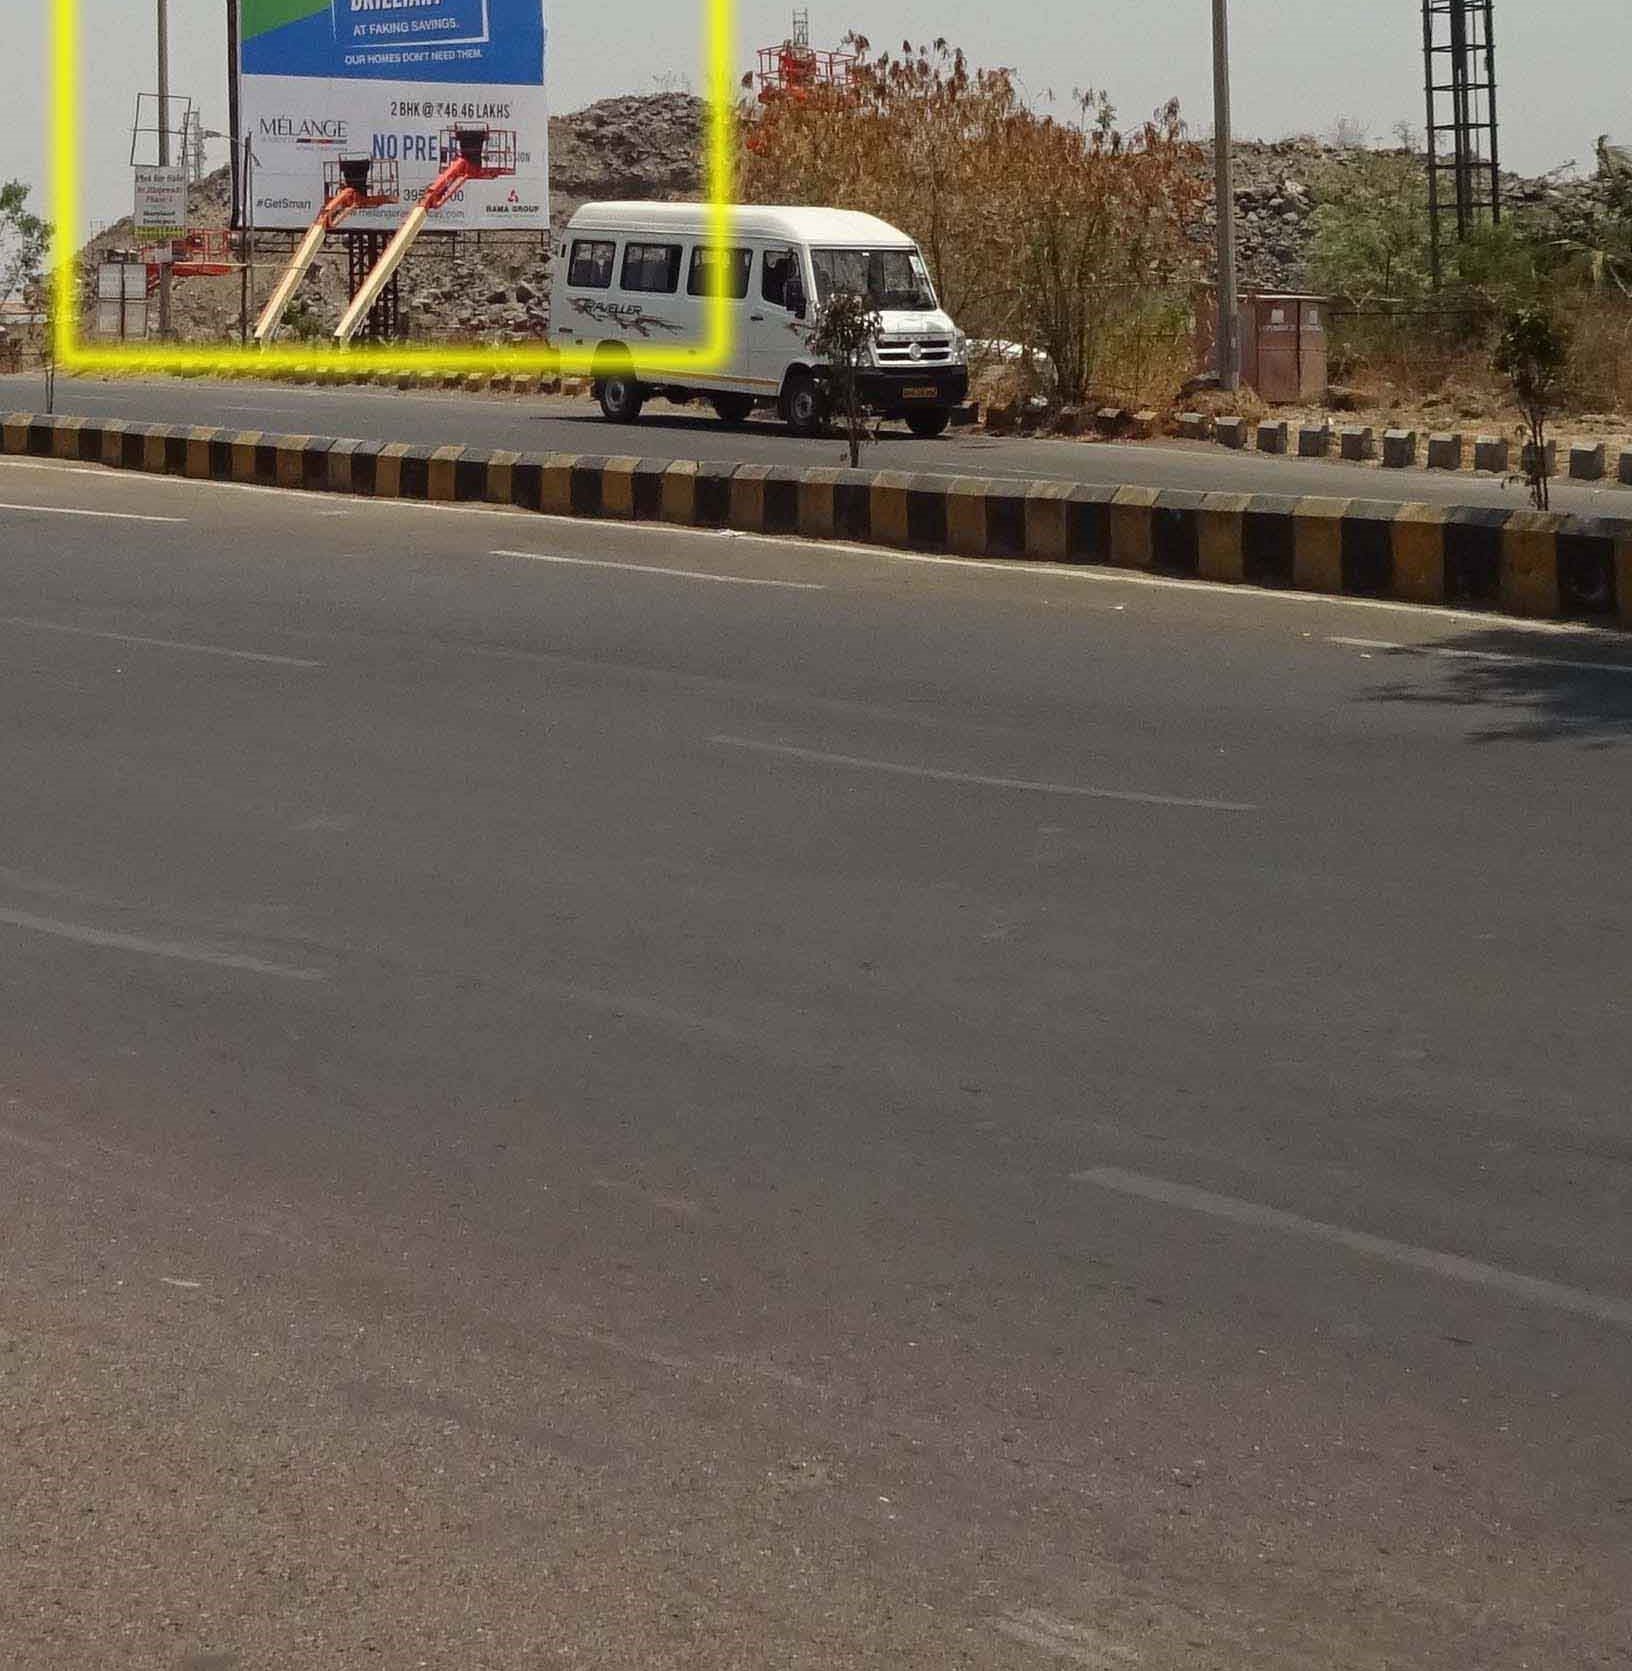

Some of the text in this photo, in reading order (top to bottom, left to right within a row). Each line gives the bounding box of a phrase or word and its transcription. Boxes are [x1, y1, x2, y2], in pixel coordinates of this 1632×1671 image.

[353, 24, 367, 37] AT
[344, 54, 366, 65] OUR
[369, 53, 400, 64] HOMES
[432, 50, 456, 61] NEED
[390, 101, 398, 117] 2
[399, 102, 421, 118] BHK
[423, 102, 434, 119] @
[476, 103, 511, 119] LAKHS
[260, 114, 349, 137] MÉLANGE
[372, 134, 398, 160] NO
